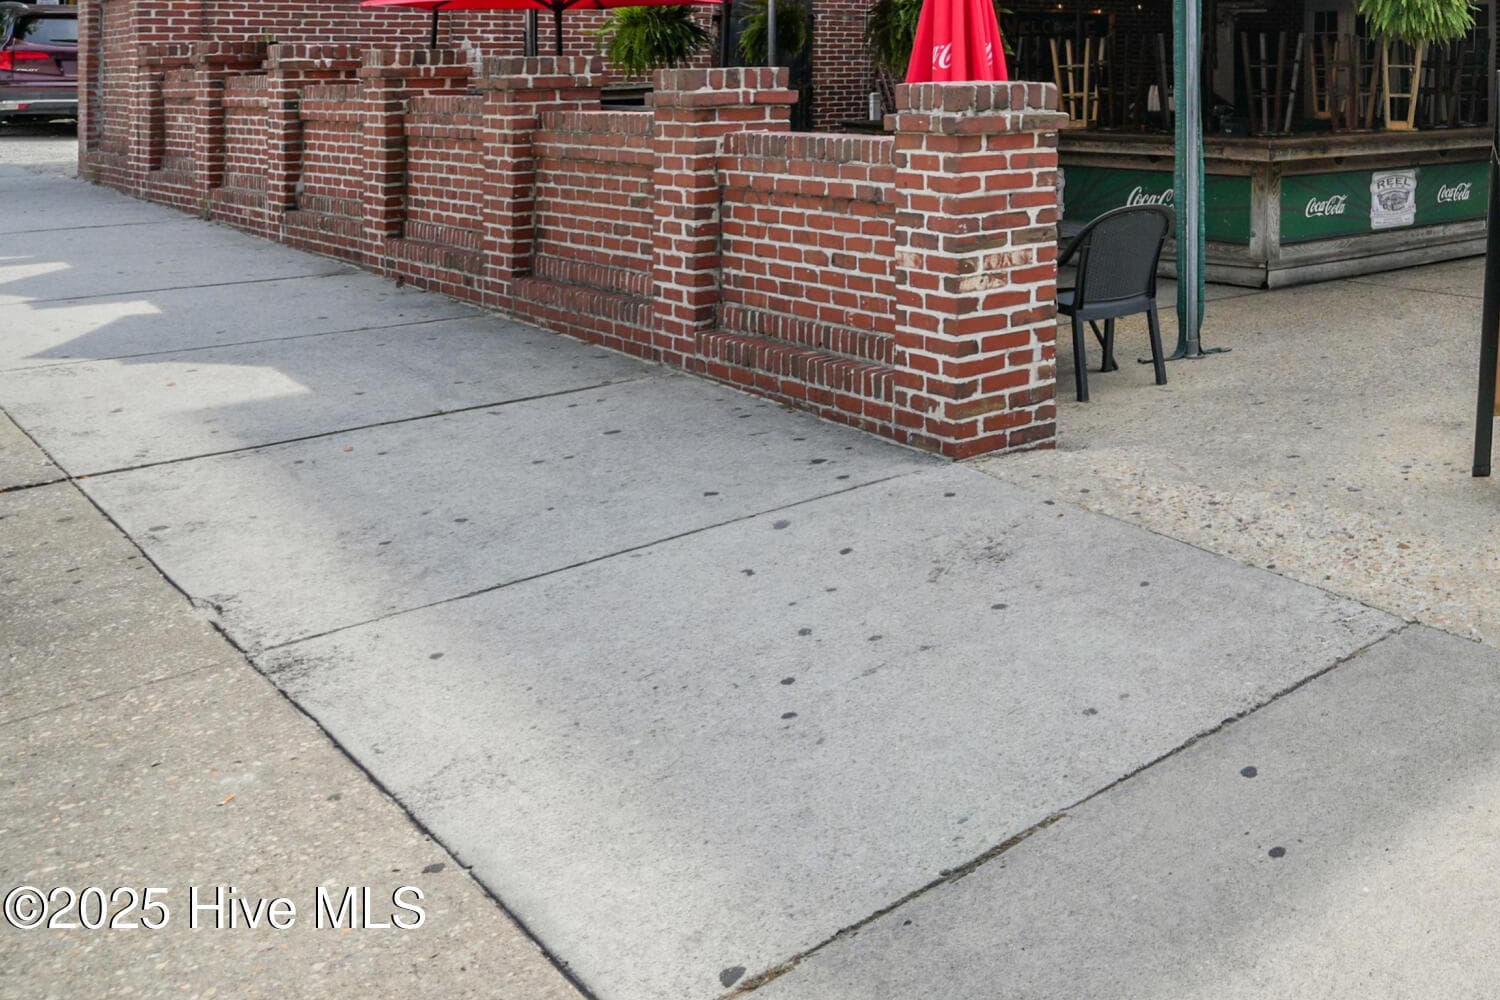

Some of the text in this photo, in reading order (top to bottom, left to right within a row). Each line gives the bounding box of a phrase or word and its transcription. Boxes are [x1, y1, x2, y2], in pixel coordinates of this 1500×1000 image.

[1376, 176, 1411, 190] REEL
[1437, 182, 1472, 203] Coca-Cola
[1305, 194, 1348, 218] Coca-Cola
